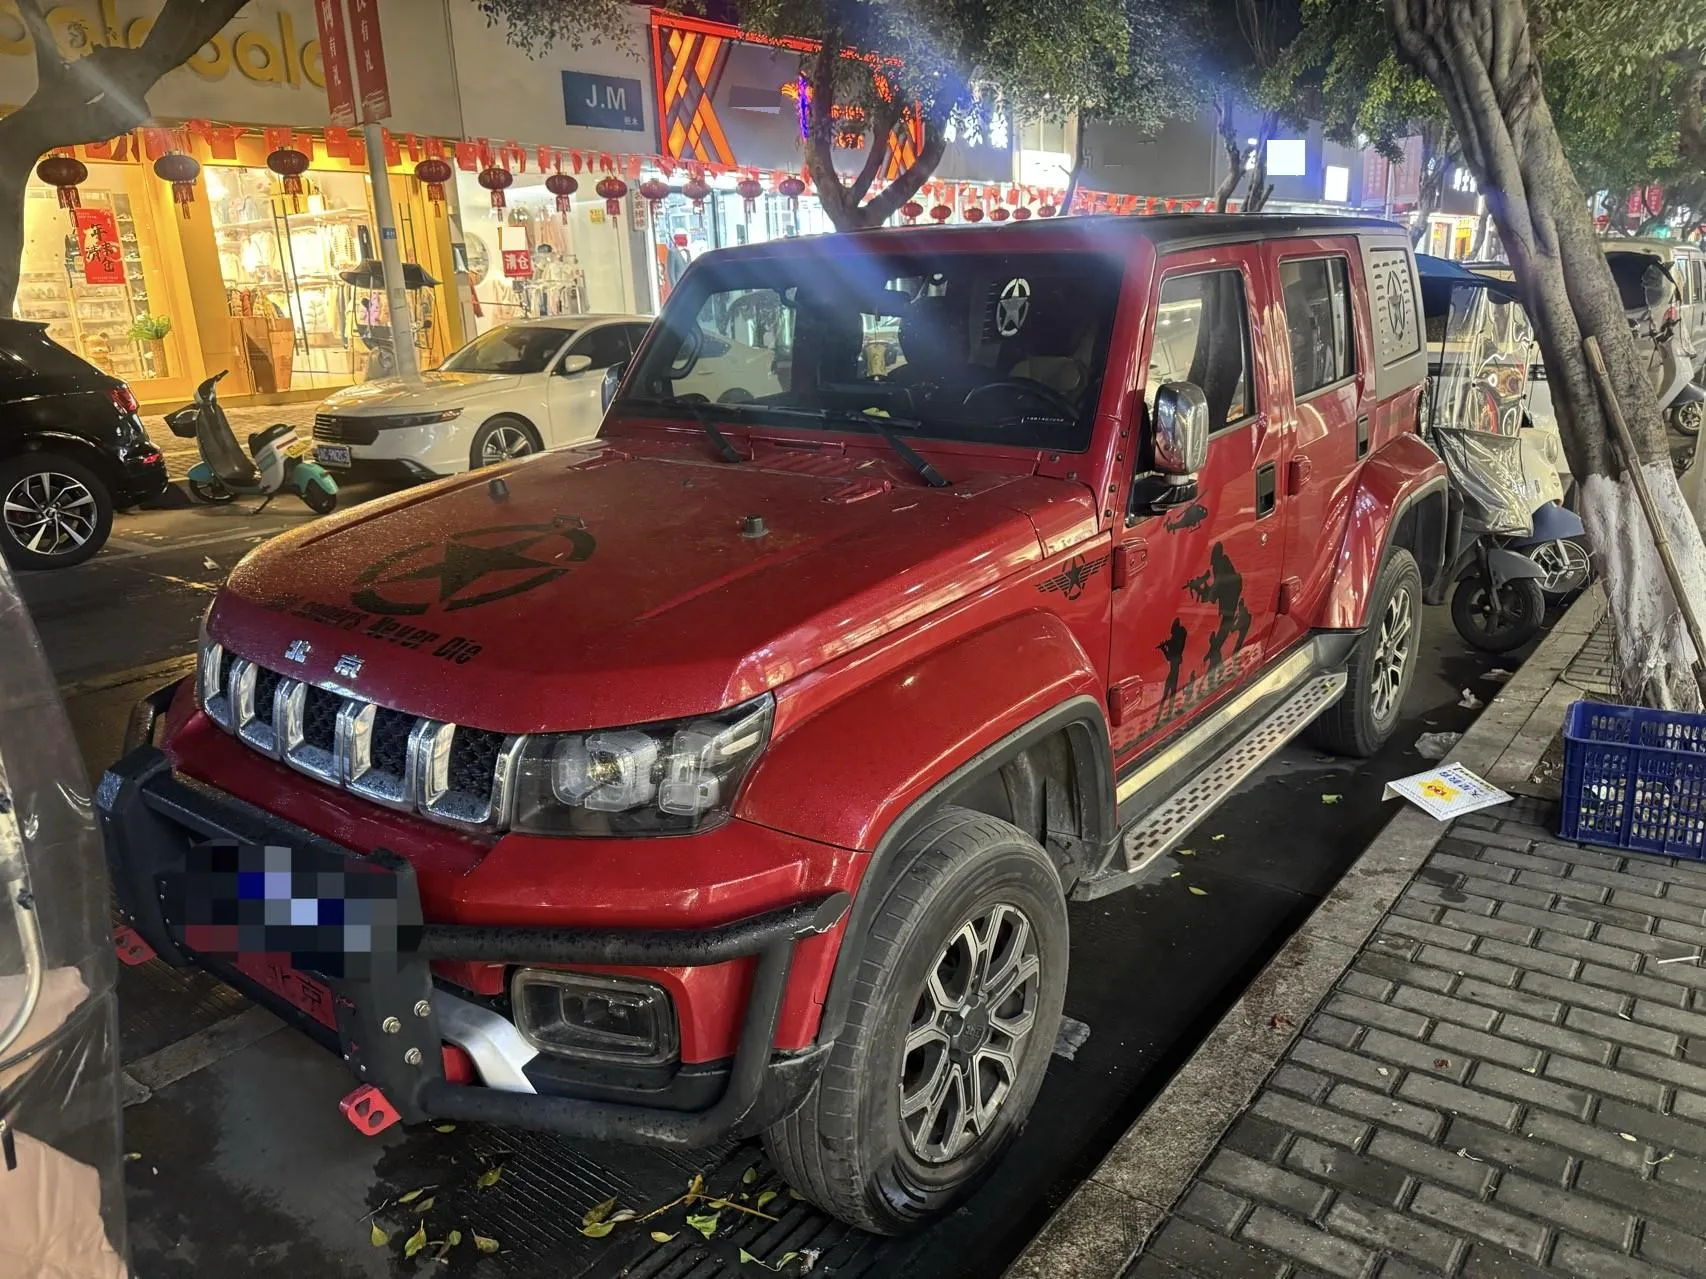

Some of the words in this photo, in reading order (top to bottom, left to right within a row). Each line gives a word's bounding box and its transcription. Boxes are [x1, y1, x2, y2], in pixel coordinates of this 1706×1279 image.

[585, 84, 626, 111] J.M
[504, 251, 529, 271] 清仓
[284, 639, 365, 679] 北京
[432, 636, 482, 664] Die
